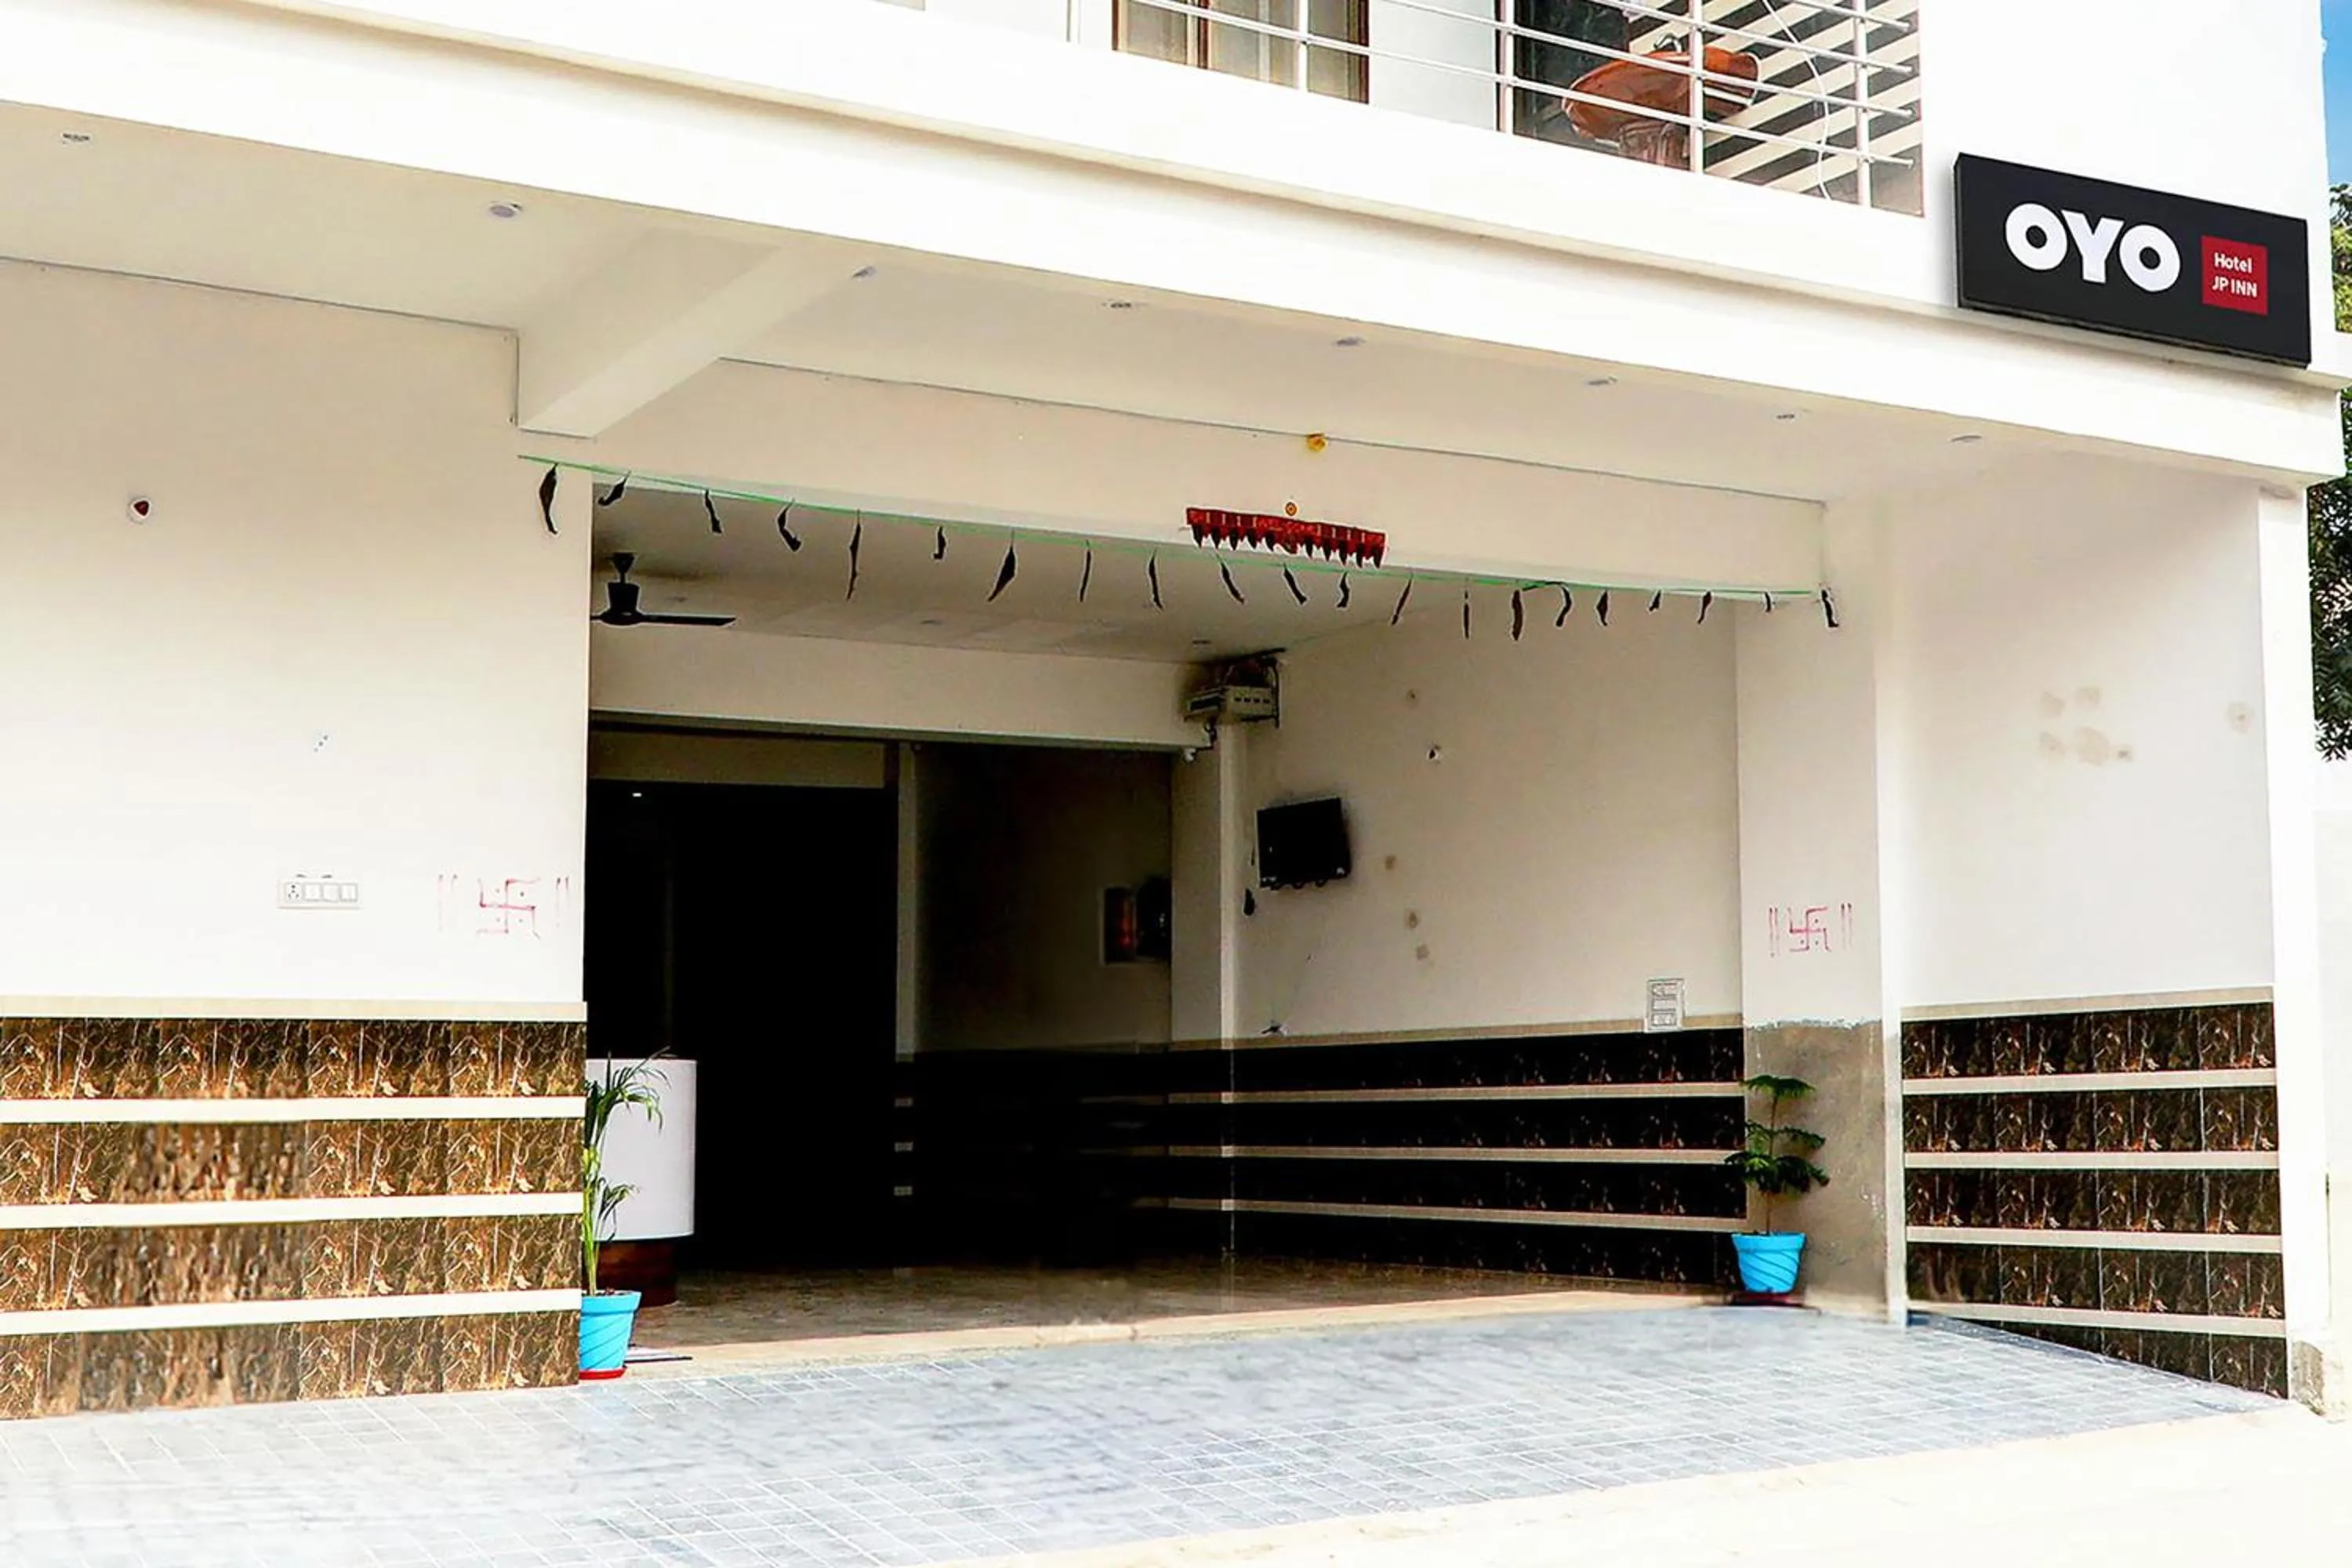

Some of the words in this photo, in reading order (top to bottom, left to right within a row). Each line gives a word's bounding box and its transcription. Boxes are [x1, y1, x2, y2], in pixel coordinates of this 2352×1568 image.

[2005, 203, 2181, 292] OYO
[2214, 252, 2252, 274] Hotel
[2212, 275, 2229, 291] JP
[2230, 278, 2257, 298] INN
